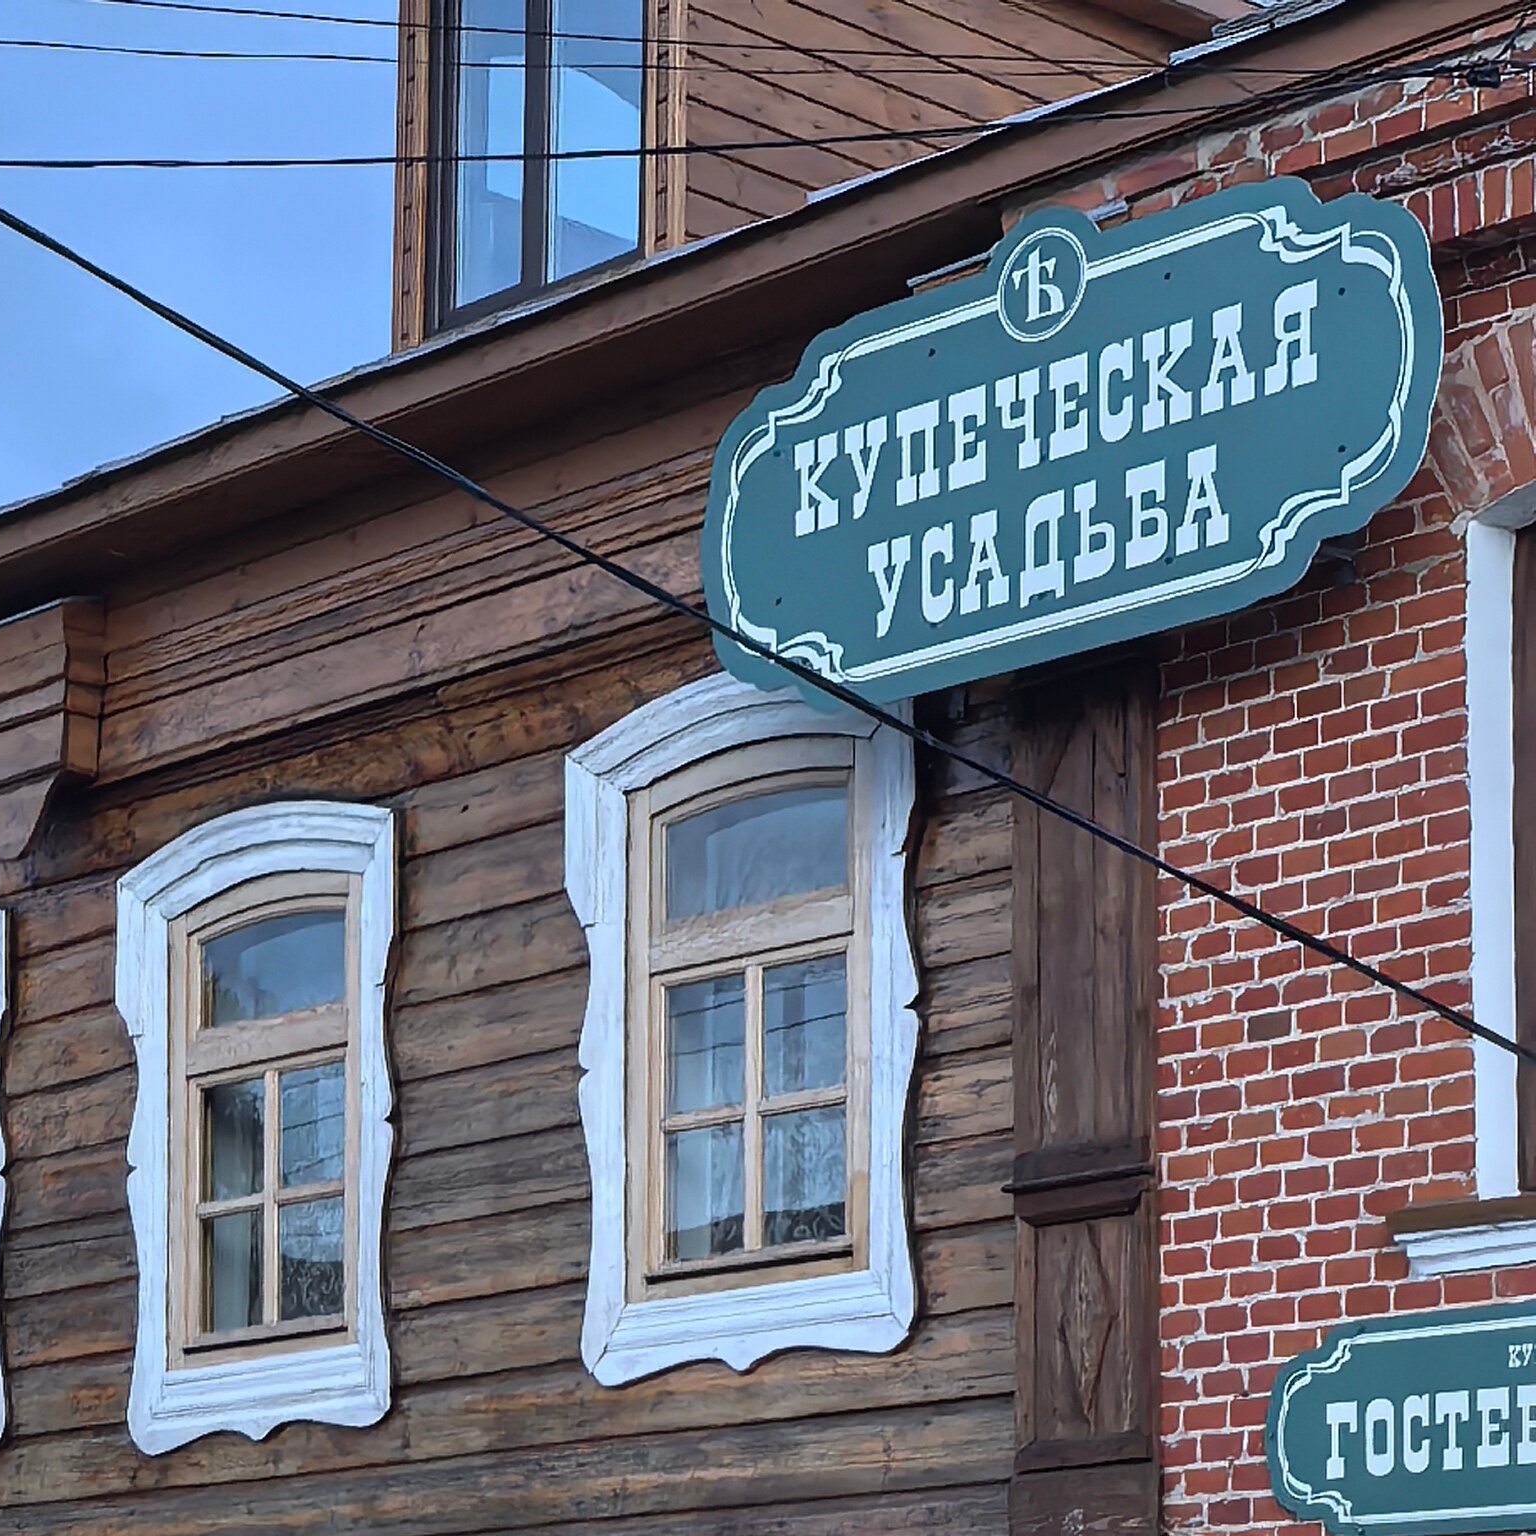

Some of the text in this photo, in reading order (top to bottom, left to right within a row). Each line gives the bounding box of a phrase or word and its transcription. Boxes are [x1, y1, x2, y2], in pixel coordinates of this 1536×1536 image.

[792, 278, 1319, 537] КУПЕЧЕСКАЯ
[866, 443, 1231, 639] УСАДЬБА
[1508, 1343, 1536, 1368] КУ
